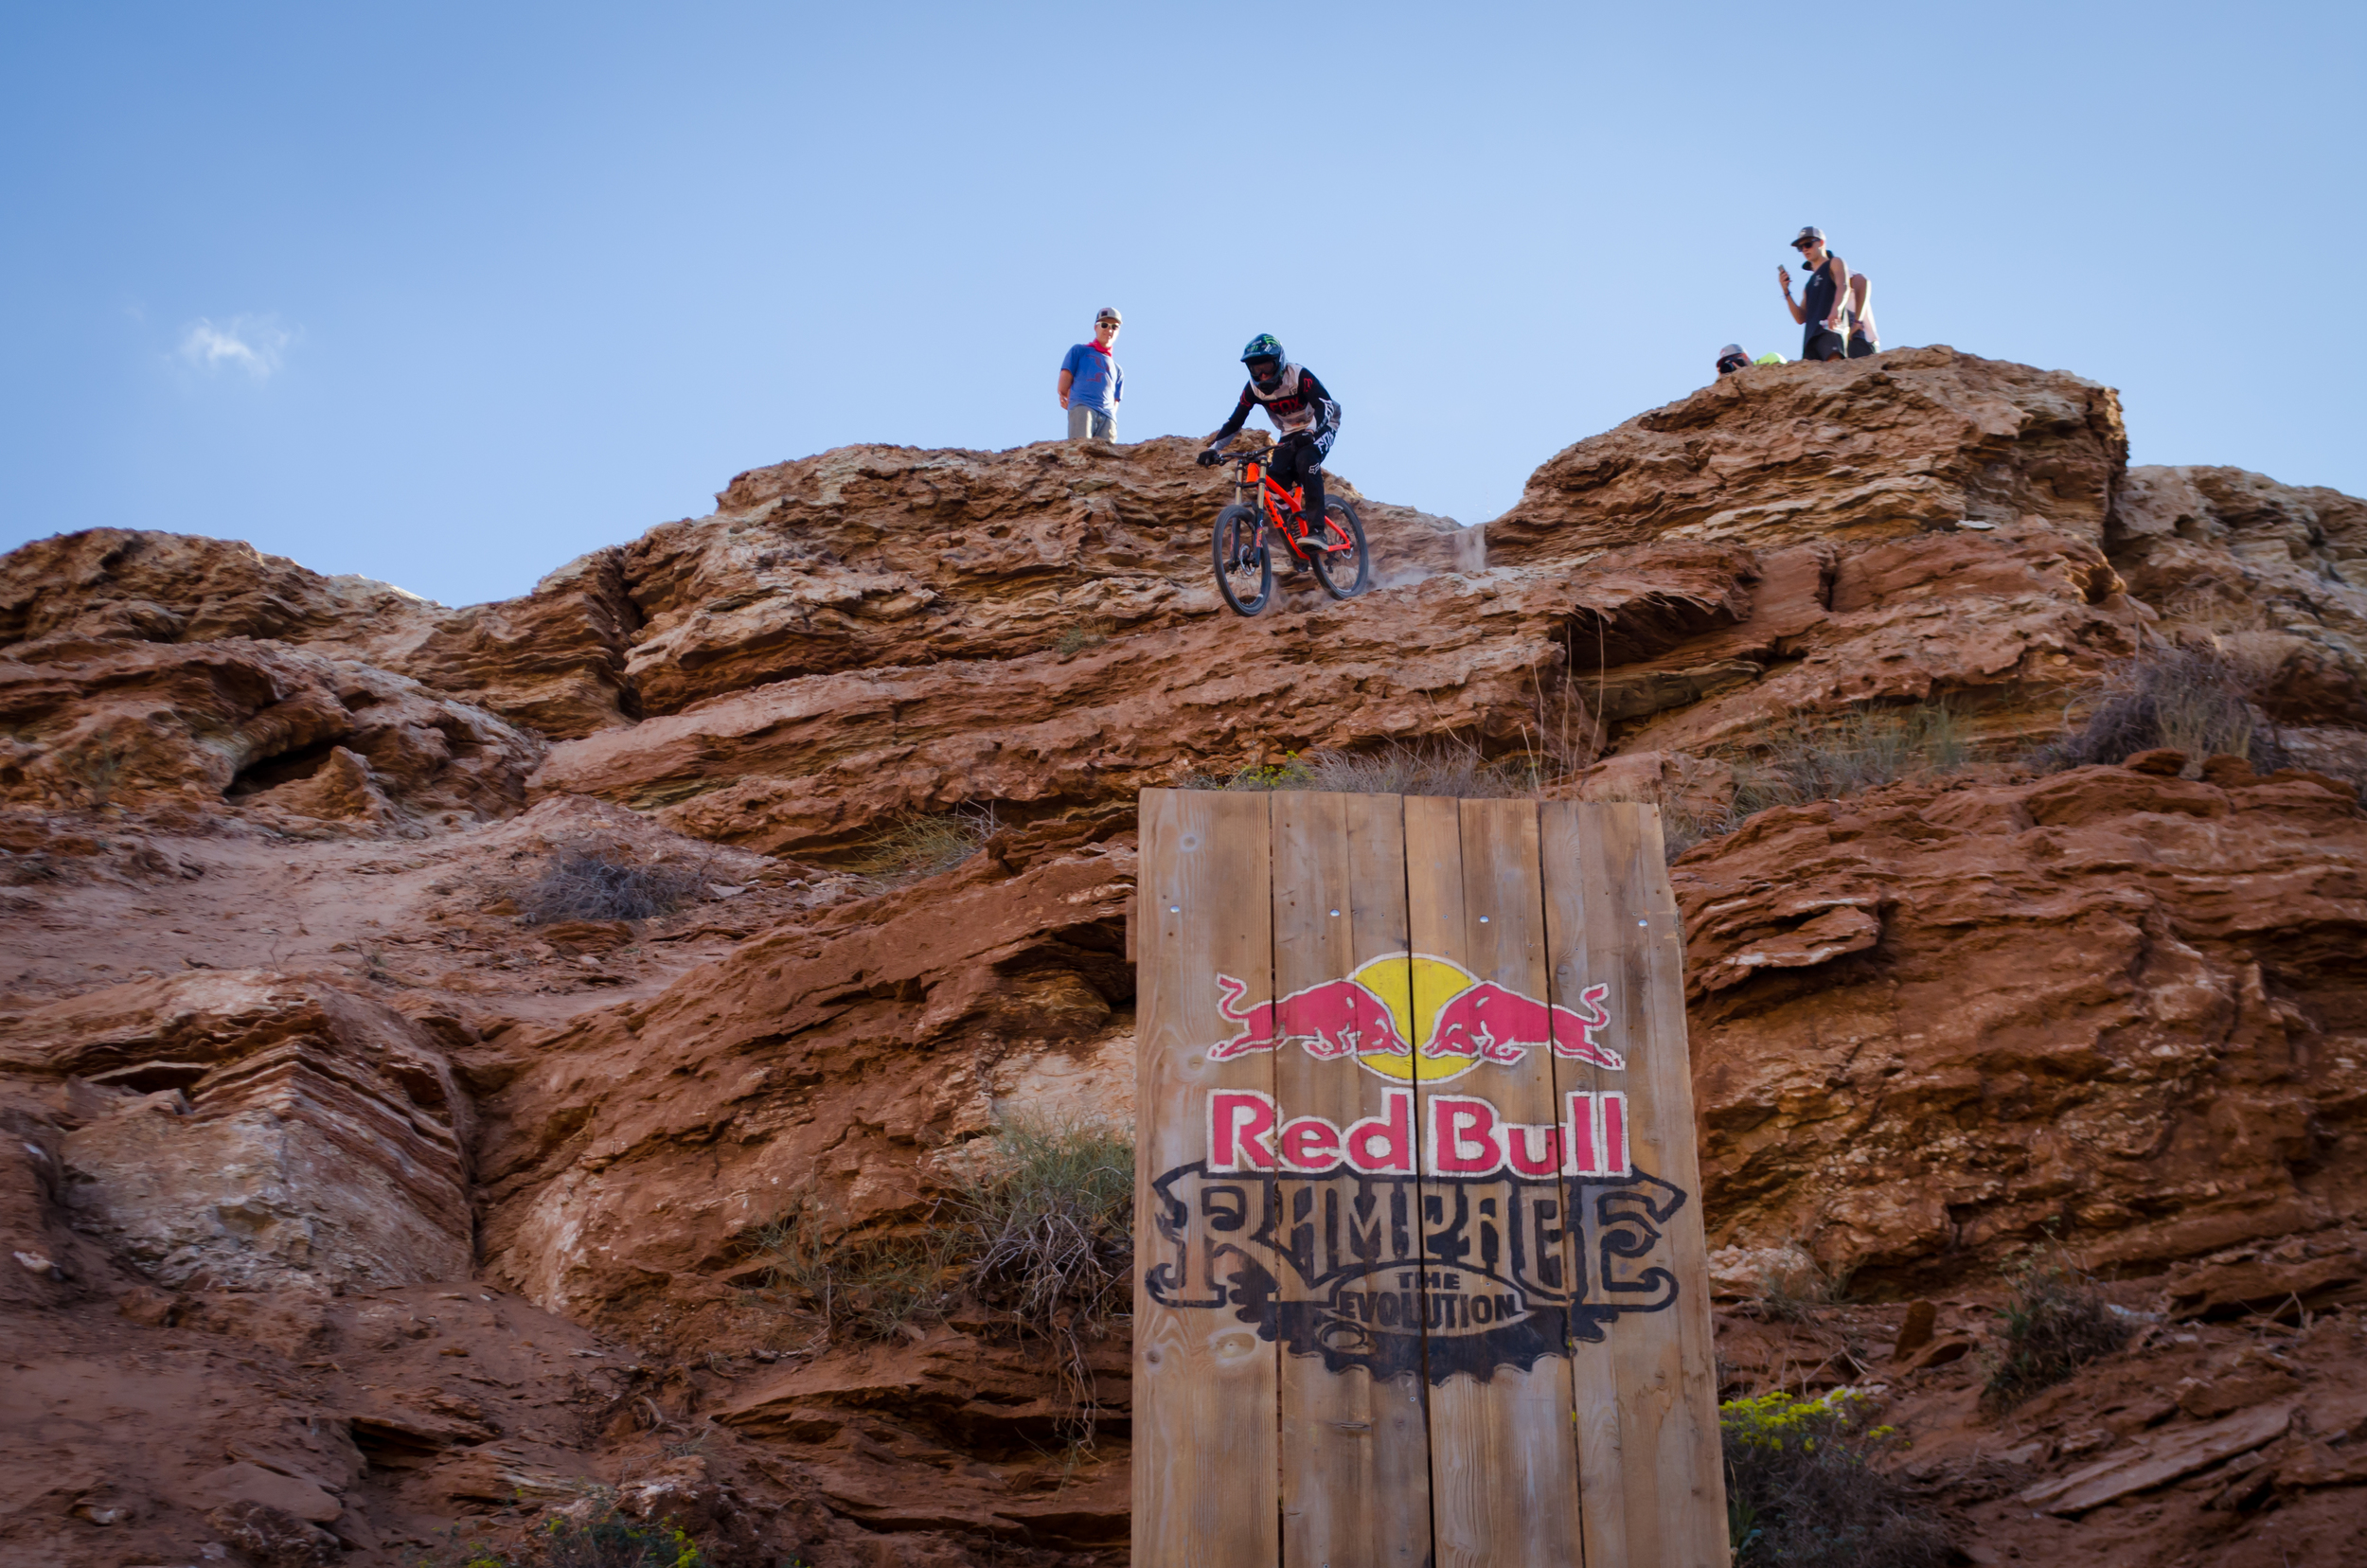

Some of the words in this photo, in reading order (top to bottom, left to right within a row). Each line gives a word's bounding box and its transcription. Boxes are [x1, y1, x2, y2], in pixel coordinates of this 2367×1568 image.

[1269, 396, 1304, 414] FOX
[1207, 1088, 1416, 1175] Red
[1428, 1091, 1631, 1180] Bull
[1145, 1161, 1687, 1309] RAMPAGE
[1397, 1272, 1460, 1290] THE
[1339, 1292, 1517, 1329] EVOLUTION
